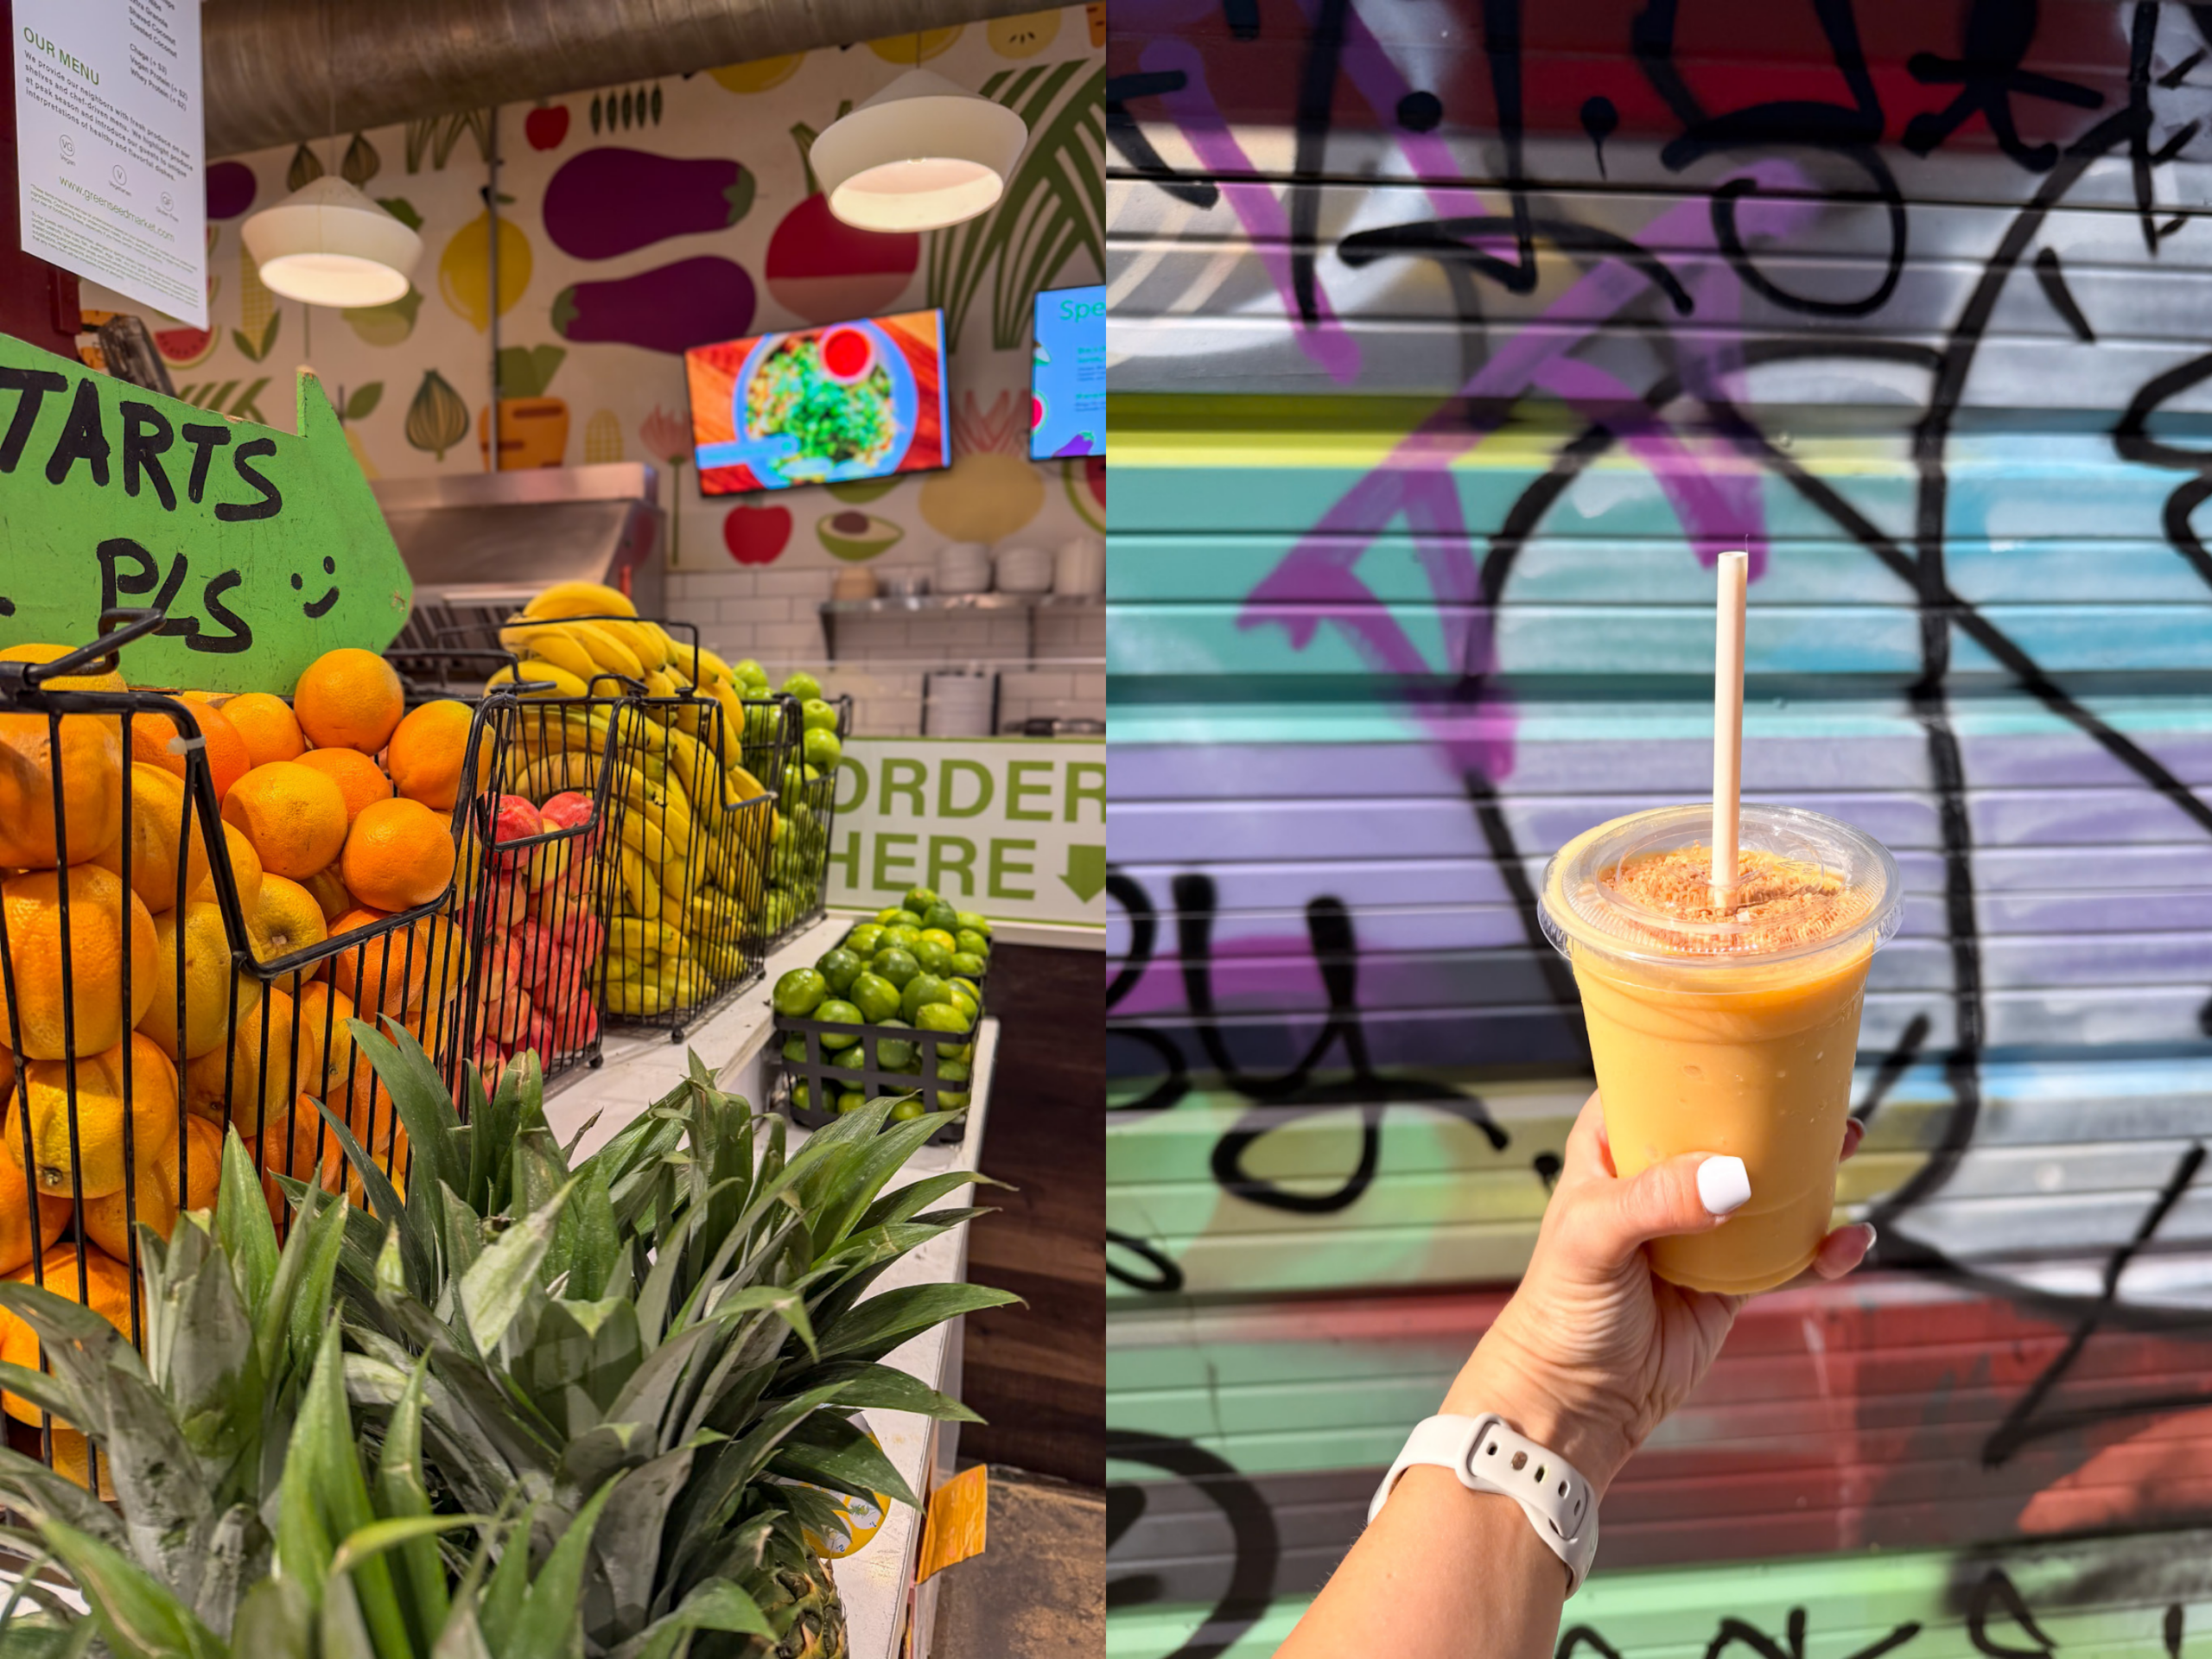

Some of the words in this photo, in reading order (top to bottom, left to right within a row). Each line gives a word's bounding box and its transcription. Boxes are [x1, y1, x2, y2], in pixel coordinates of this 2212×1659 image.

[24, 27, 55, 58] OUR
[60, 48, 99, 86] MENU
[148, 79, 168, 99] Protein
[149, 69, 170, 88] Protein
[24, 50, 35, 63] We
[38, 60, 65, 81] provide
[67, 79, 79, 89] our
[80, 86, 113, 111] neighbors
[115, 109, 129, 121] with
[130, 117, 146, 131] fresh
[147, 129, 171, 148] produce
[181, 150, 190, 159] our
[25, 64, 53, 86] shelves
[54, 82, 68, 95] and
[69, 92, 108, 119] chef-driven
[110, 117, 129, 132] menu.
[132, 129, 141, 140] We
[143, 136, 169, 156] highlight
[170, 154, 193, 171] produce
[26, 77, 33, 86] at
[35, 82, 53, 98] peak
[54, 94, 79, 113] season
[81, 111, 93, 122] and
[95, 117, 126, 141] introduce
[127, 138, 137, 148] our
[139, 145, 159, 161] guests
[160, 157, 167, 166] to
[26, 86, 79, 124] interpretations
[89, 124, 114, 146] healthy
[115, 142, 127, 153] and
[128, 148, 154, 168] flavorful
[155, 165, 175, 181] dishes.
[60, 153, 75, 166] Vegan
[61, 138, 73, 153] VG
[59, 175, 175, 243] www.greenseedmarket.com
[1060, 299, 1106, 322] Spe
[0, 366, 283, 522] TARTS
[832, 756, 1106, 823] ORDER
